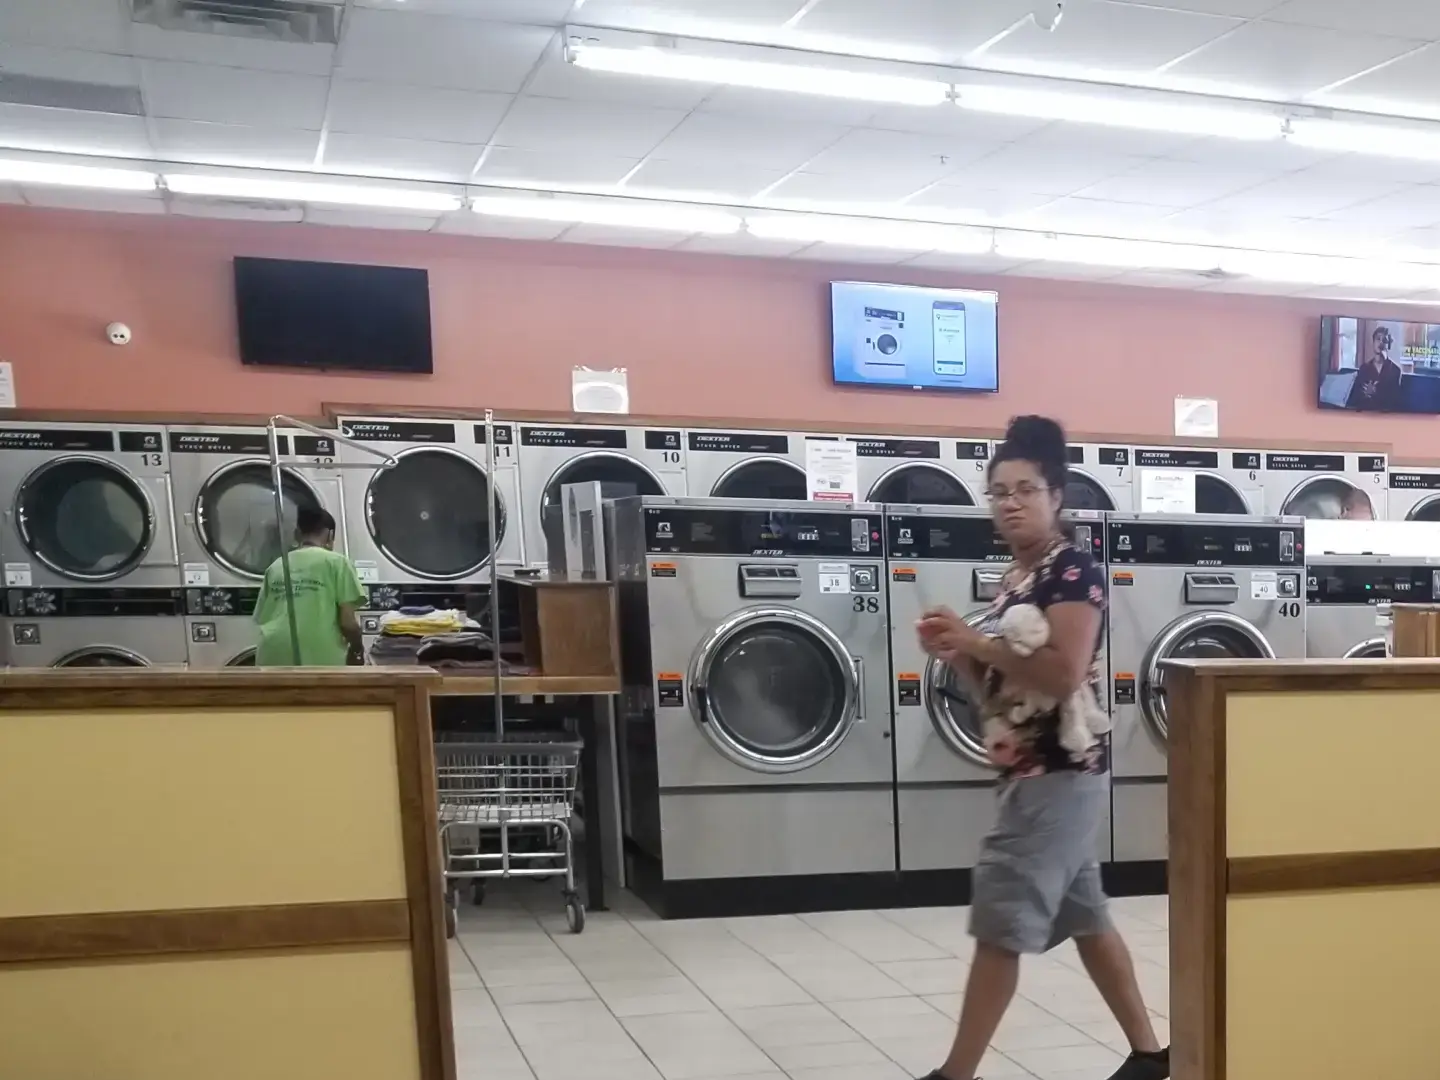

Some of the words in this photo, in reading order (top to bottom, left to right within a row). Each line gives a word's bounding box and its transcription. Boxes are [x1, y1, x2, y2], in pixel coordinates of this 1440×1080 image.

[140, 453, 163, 467] 13
[662, 451, 681, 464] 10
[975, 460, 984, 472] 8
[1116, 466, 1125, 477] 7
[1248, 470, 1257, 481] 6
[1373, 473, 1381, 484] 5
[852, 595, 880, 613] 38
[1278, 602, 1301, 618] 40
